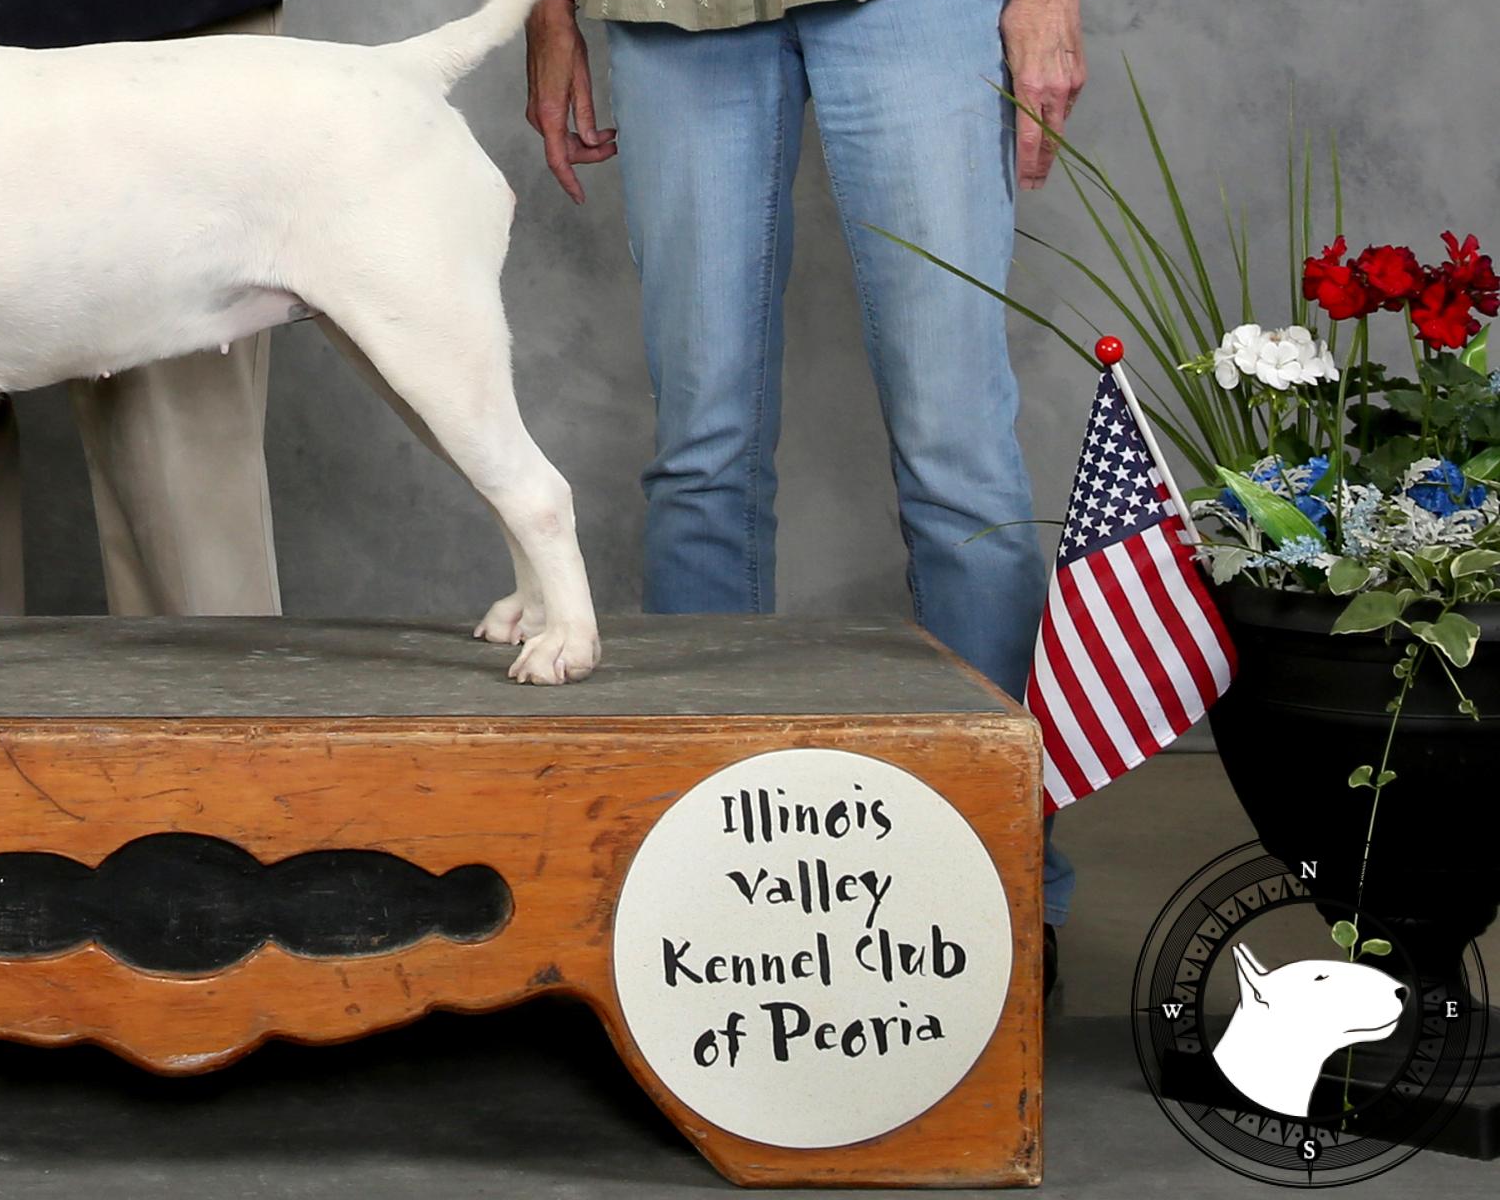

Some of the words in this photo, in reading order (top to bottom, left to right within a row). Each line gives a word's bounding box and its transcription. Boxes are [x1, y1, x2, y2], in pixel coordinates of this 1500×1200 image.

[720, 783, 893, 844] Illinois
[662, 932, 832, 988] Kennel
[694, 1012, 747, 1068] of
[760, 1000, 946, 1062] Peoria
